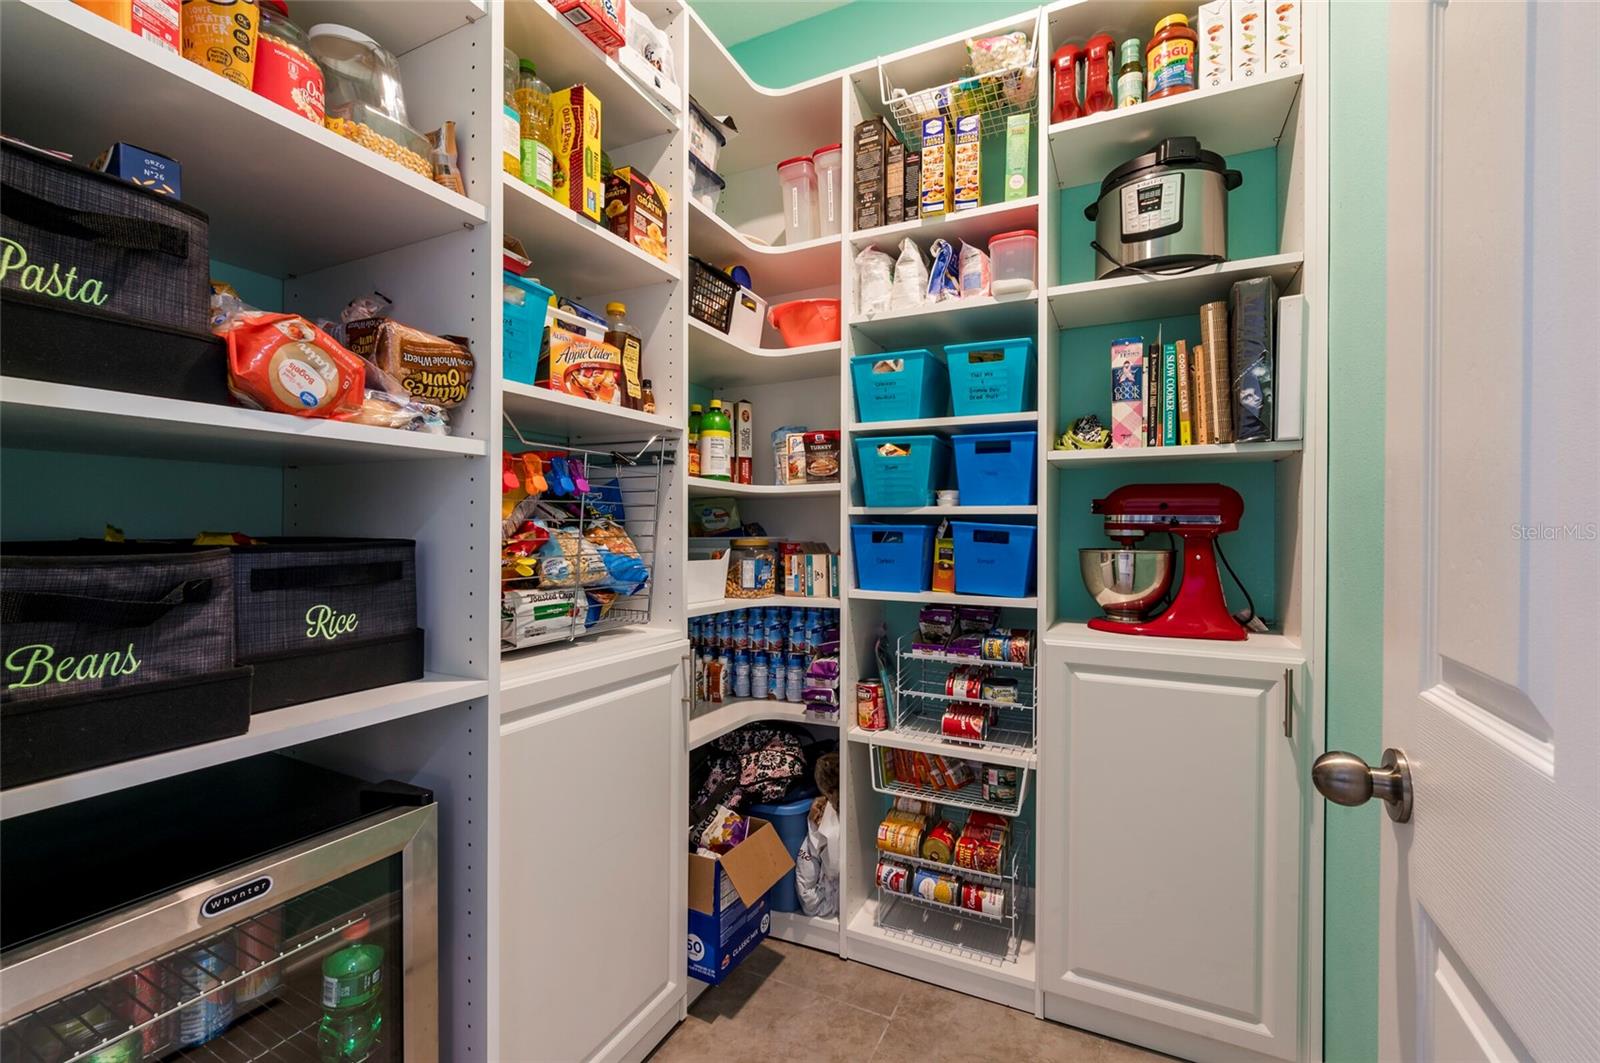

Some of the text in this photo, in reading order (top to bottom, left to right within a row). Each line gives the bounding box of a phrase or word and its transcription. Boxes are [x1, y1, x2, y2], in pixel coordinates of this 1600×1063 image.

[144, 158, 165, 170] ORZO
[0, 236, 108, 306] Pasta
[403, 352, 432, 366] Wheat
[432, 356, 457, 367] Whole
[556, 345, 613, 364] Apple Cider
[422, 368, 460, 386] Own
[1178, 354, 1186, 386] COOKING
[1166, 355, 1175, 438] SLOW COOKER COOKBOOK
[527, 592, 557, 603] Toasted
[305, 604, 358, 641] Rice
[4, 643, 142, 689] Beans
[693, 808, 719, 844] BAKED
[210, 882, 266, 909] Whynter
